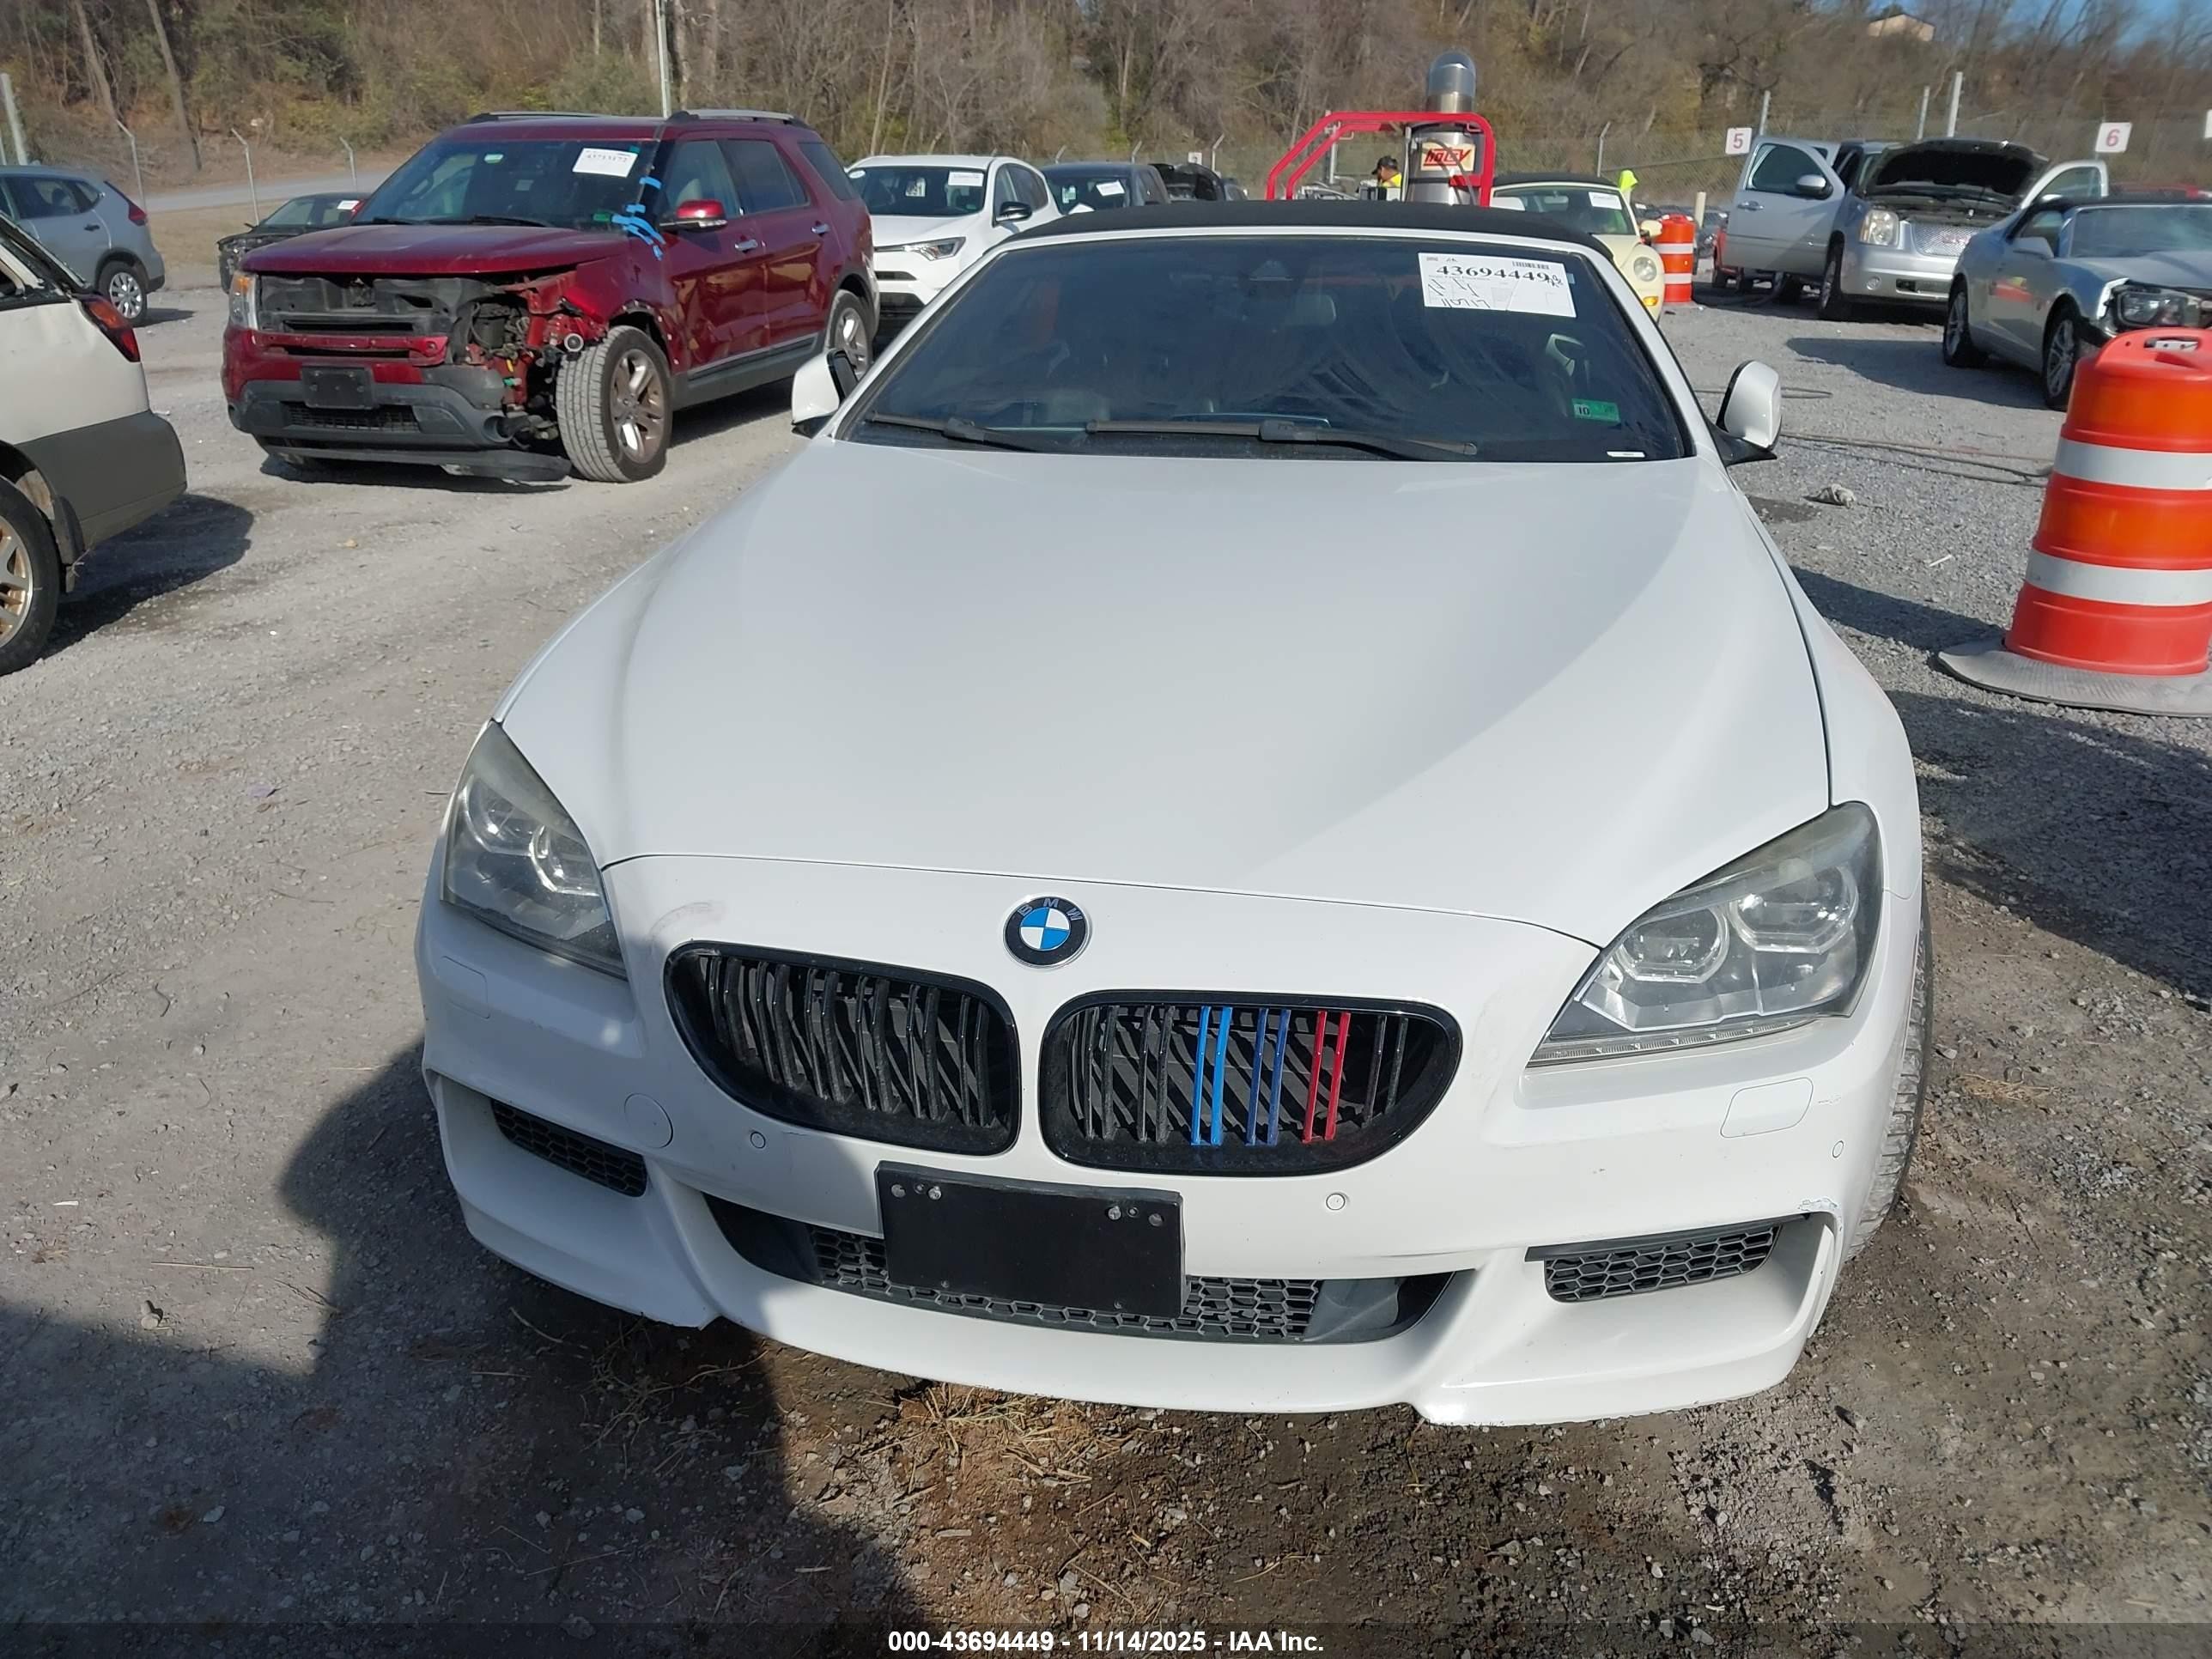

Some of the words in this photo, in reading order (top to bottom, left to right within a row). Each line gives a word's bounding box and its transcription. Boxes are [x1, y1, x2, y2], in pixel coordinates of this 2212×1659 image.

[1733, 133, 1744, 149] 5
[2106, 129, 2120, 147] 6
[1436, 265, 1550, 283] 43694449
[1018, 897, 1084, 921] BMW
